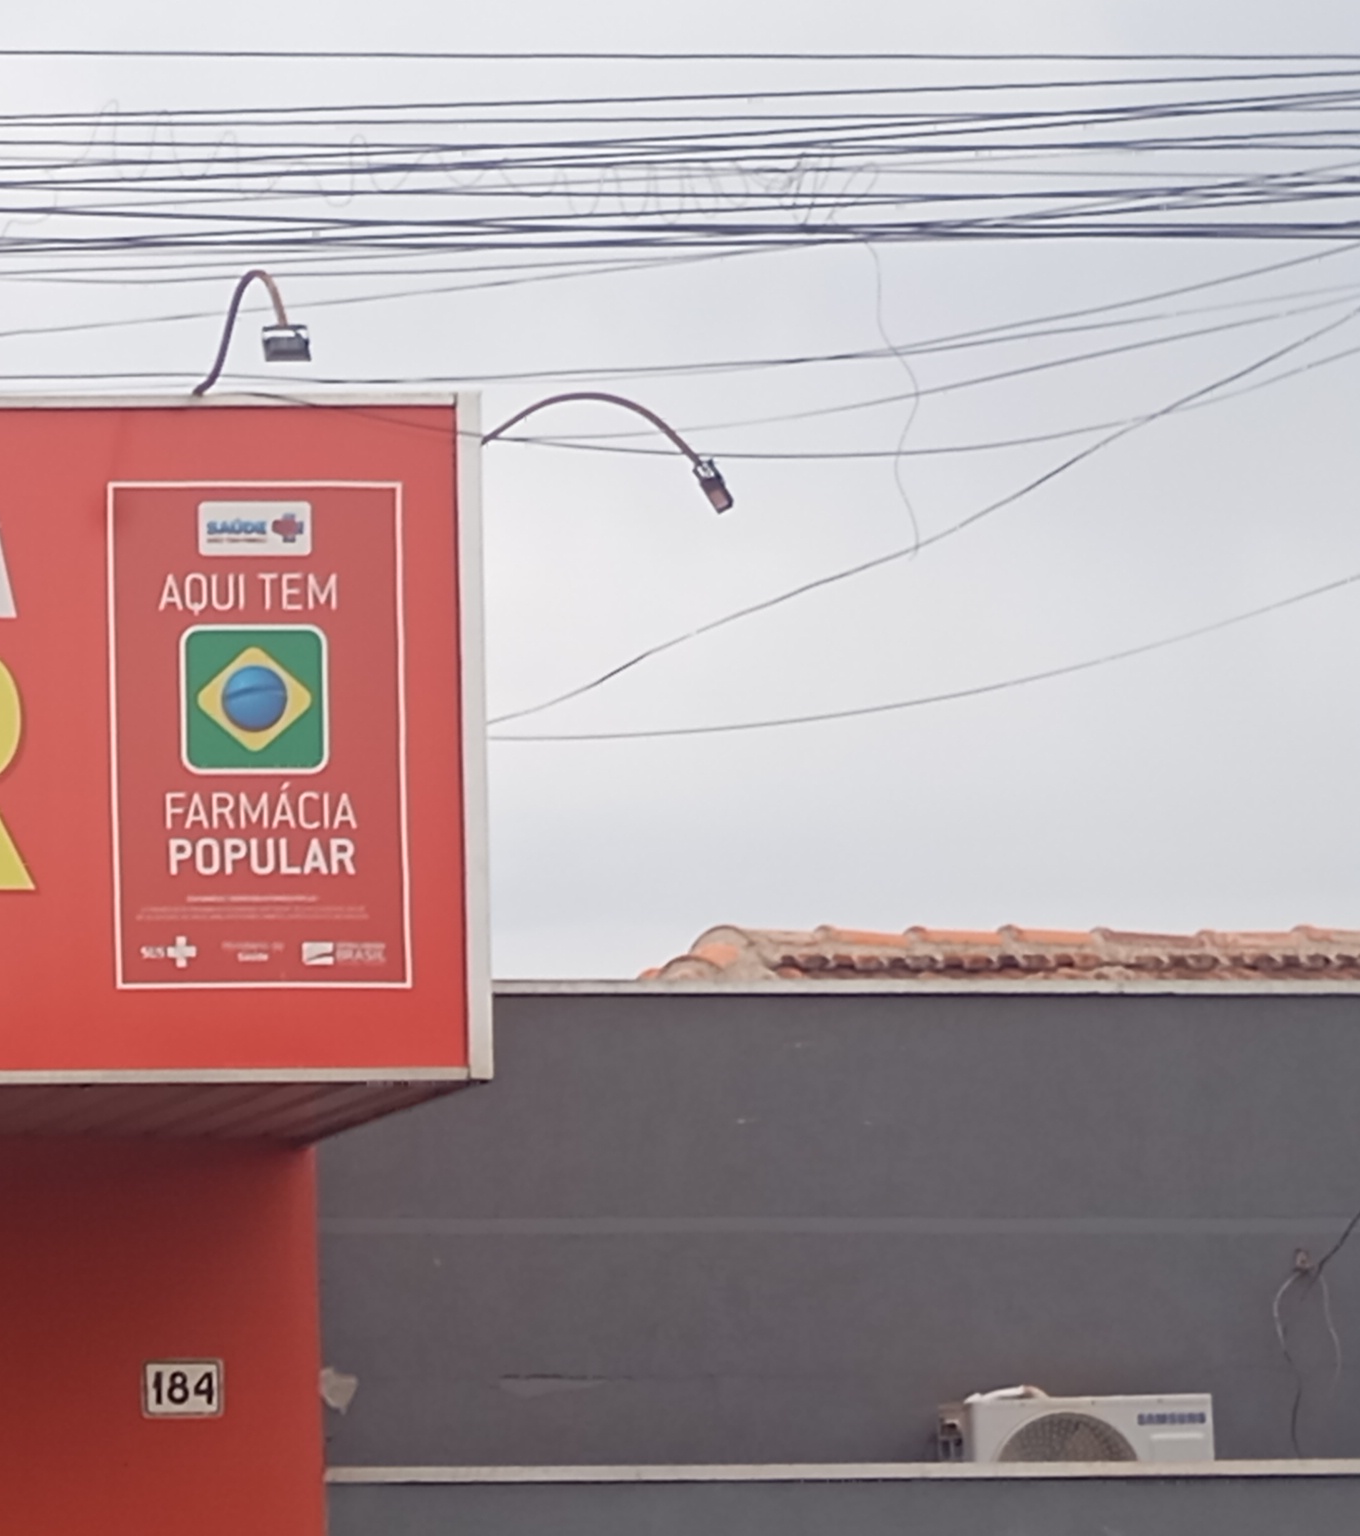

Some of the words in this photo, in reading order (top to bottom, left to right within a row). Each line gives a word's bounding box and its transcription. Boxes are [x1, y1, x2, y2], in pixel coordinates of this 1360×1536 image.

[158, 572, 246, 616] AQUI
[257, 572, 338, 611] TEM
[165, 781, 358, 830] FARMÁCIA
[168, 837, 357, 876] POPULAR
[152, 1370, 214, 1406] 184
[1137, 1411, 1206, 1426] SAMSUNG
